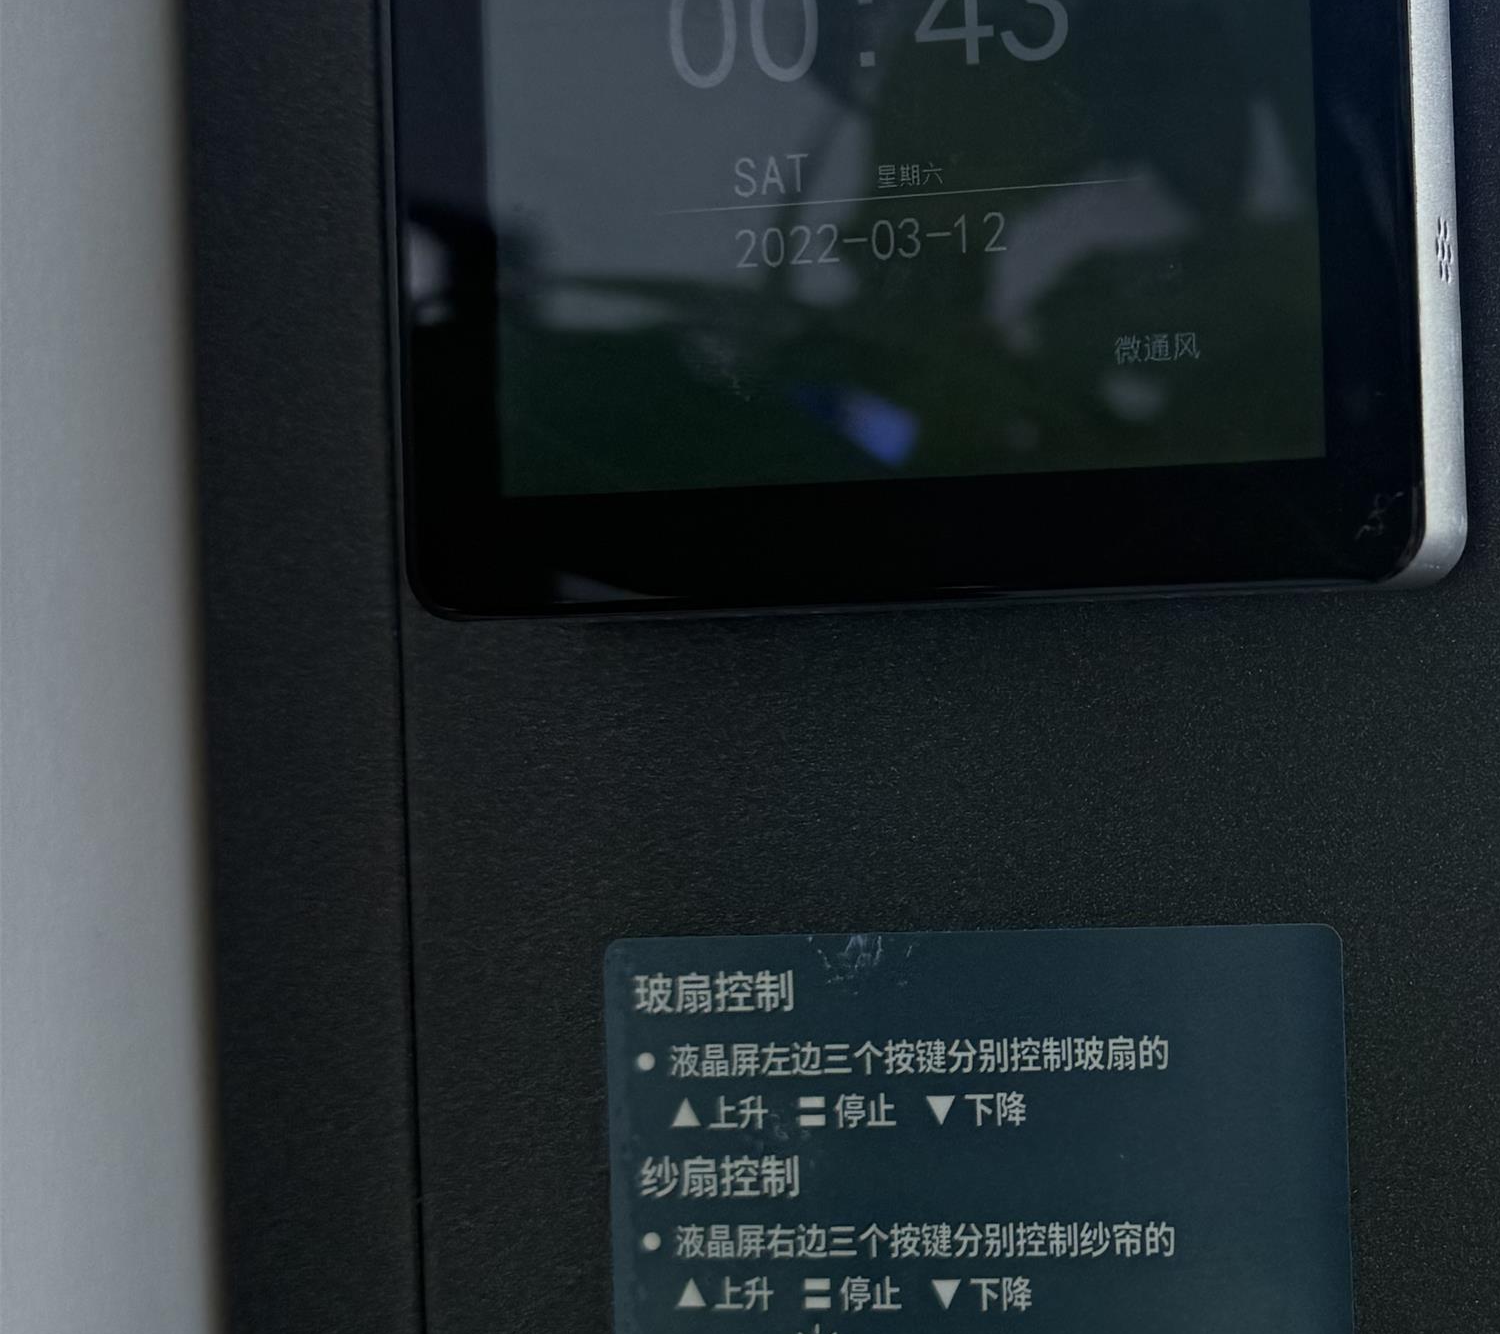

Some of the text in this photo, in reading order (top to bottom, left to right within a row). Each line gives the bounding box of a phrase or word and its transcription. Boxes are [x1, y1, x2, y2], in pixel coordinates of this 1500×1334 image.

[733, 153, 809, 198] SAT
[877, 163, 943, 189] 星期六
[735, 212, 1008, 269] 2022-03-12
[1114, 332, 1200, 365] 微通风
[634, 969, 794, 1015] 玻扇控制
[669, 1036, 1169, 1079] 液晶屏左边三个按键分别控制玻扇的
[707, 1092, 1027, 1130] 上升 停止 下降
[639, 1155, 800, 1200] 纱扇控制
[674, 1222, 1176, 1259] 液晶屏右边三个按键分别控制纱帘的
[713, 1277, 1033, 1313] 上升 停止 下降
